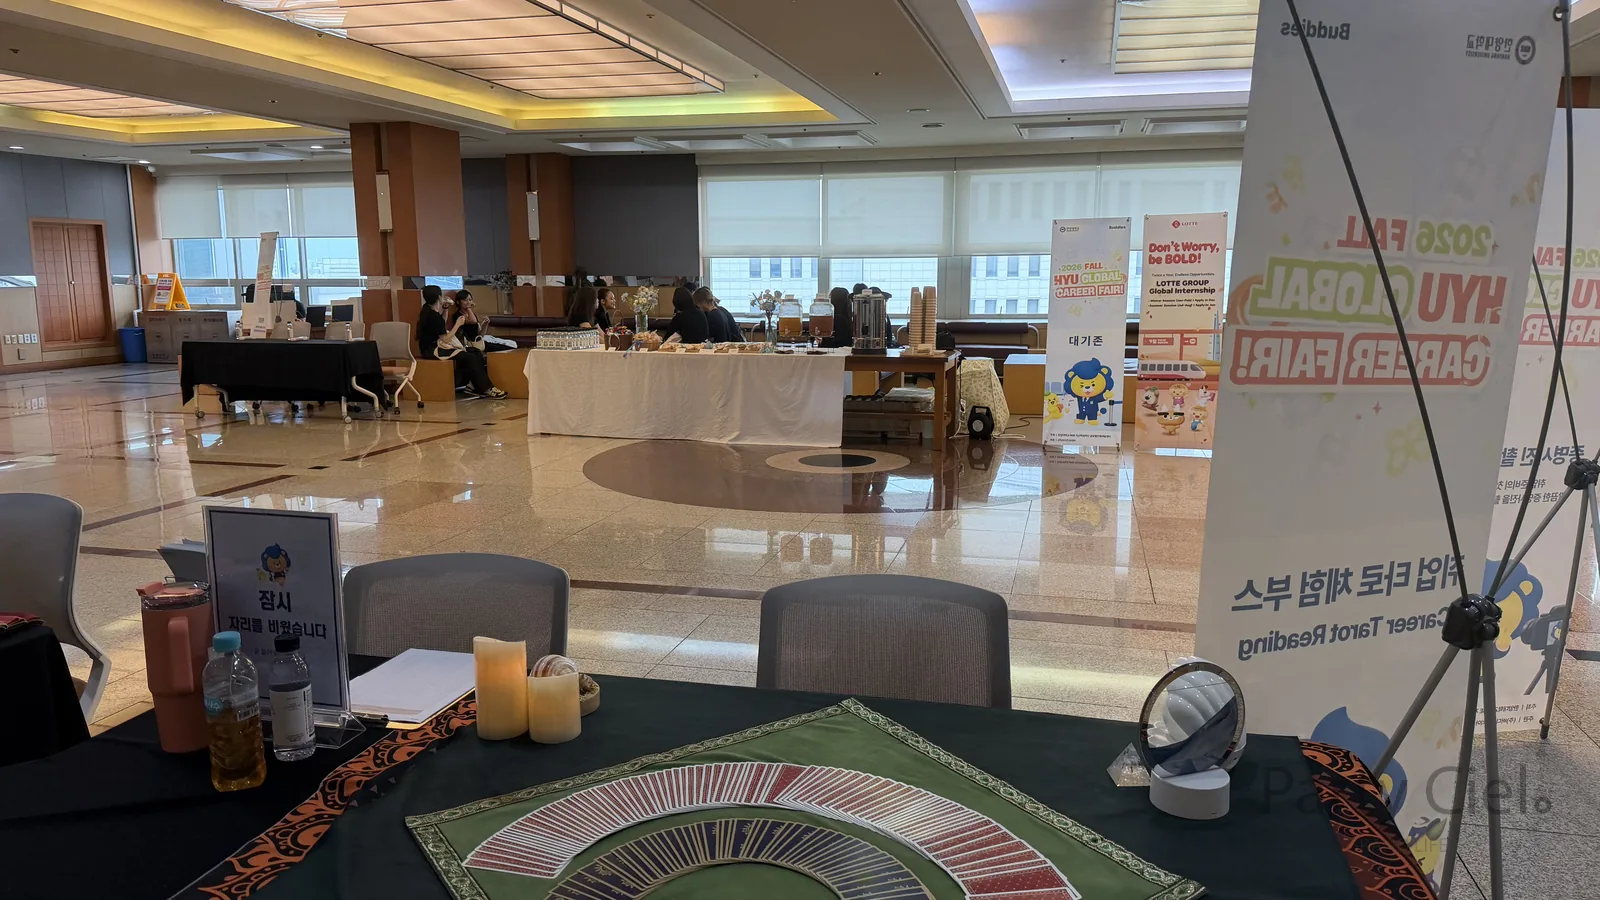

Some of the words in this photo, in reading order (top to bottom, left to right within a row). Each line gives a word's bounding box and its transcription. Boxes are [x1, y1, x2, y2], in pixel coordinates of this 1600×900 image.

[1148, 241, 1180, 253] Don't
[1181, 242, 1220, 254] Worry,
[1148, 254, 1163, 265] be
[1165, 253, 1202, 264] BOLD!
[1061, 264, 1082, 272] 2026
[1084, 262, 1103, 270] FALL
[1054, 273, 1079, 286] HYU
[1081, 271, 1121, 283] GLOBAL
[1182, 279, 1210, 287] GROUP
[1056, 286, 1096, 298] CAREER
[1098, 284, 1124, 296] FAIR!
[1175, 287, 1216, 295] Internship
[1069, 335, 1103, 347] 대기존
[258, 589, 293, 613] 잠시
[228, 615, 264, 635] 자리를
[268, 618, 328, 640] 비웠습니다
